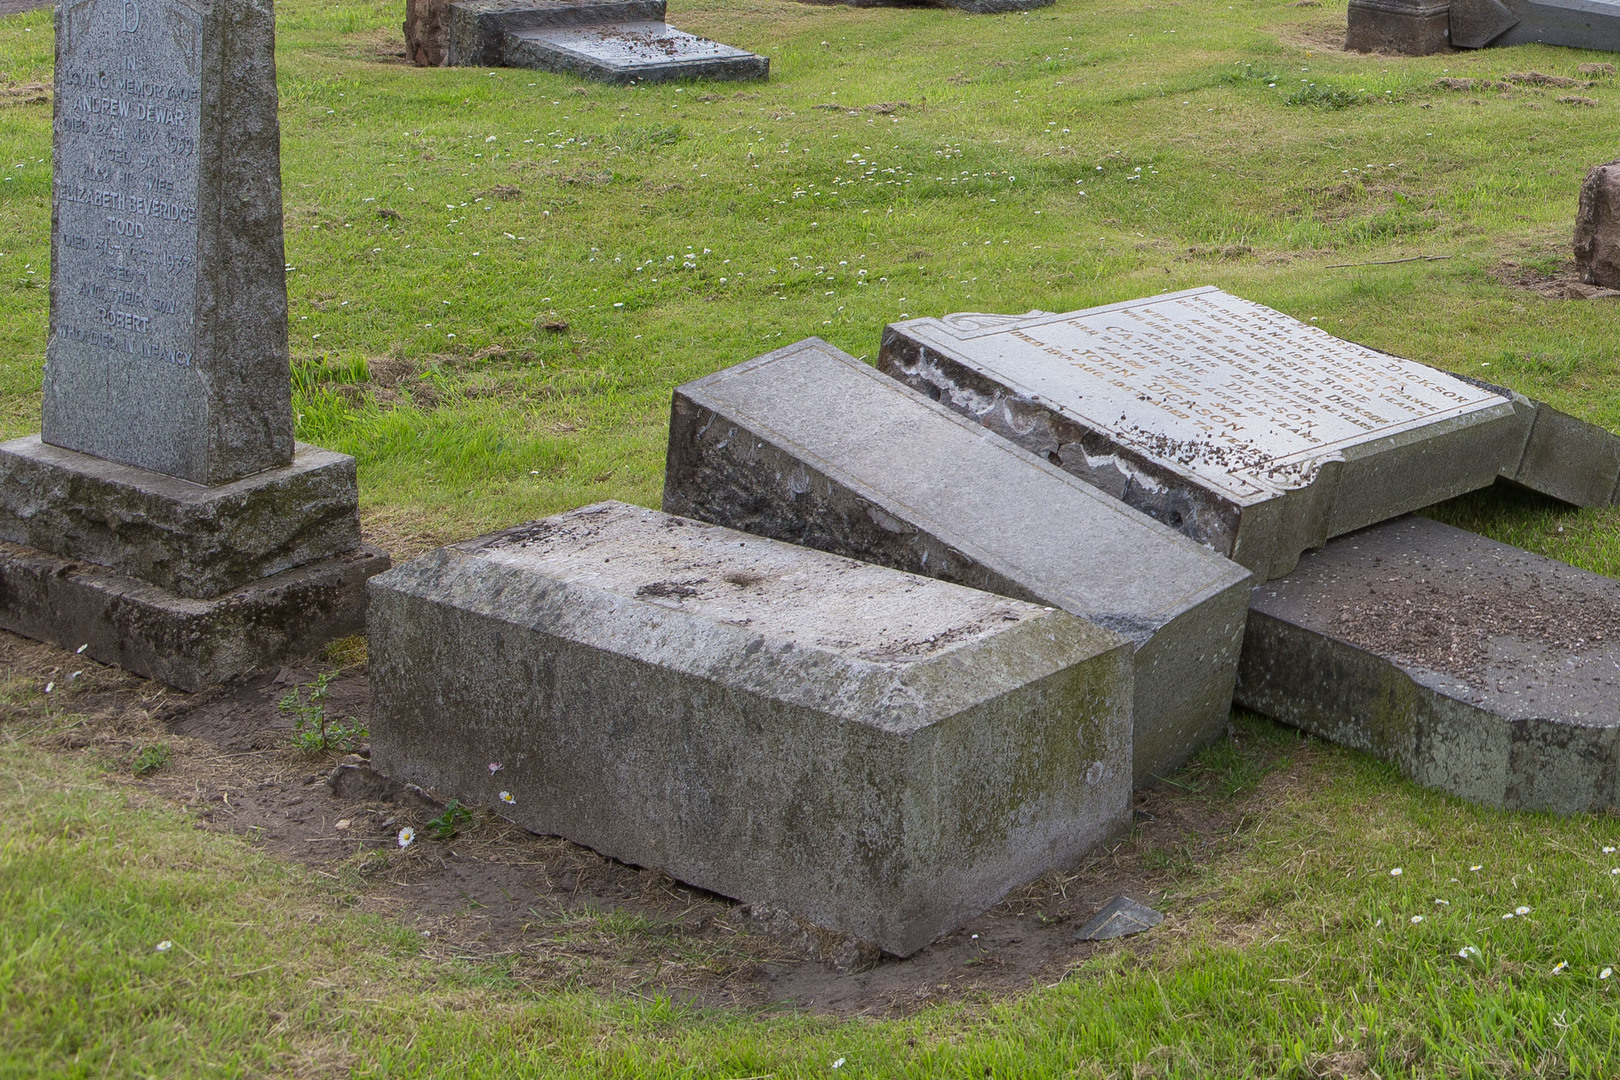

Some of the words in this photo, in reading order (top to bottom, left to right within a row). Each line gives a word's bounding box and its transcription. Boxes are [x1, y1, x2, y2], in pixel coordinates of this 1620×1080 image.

[121, 0, 140, 33] D
[124, 55, 136, 71] IN
[65, 70, 109, 90] LOVING
[117, 79, 174, 99] MEMORY
[63, 118, 89, 133] DIED
[74, 95, 130, 117] ANDREW
[137, 103, 185, 126] DEWAR
[98, 148, 132, 164] AGED
[60, 185, 125, 211] ELIZABETH
[129, 196, 197, 224] BEVERIDGE
[147, 176, 174, 195] WIFE
[63, 234, 89, 249] DIED
[107, 217, 144, 238] TODD
[101, 266, 133, 282] AGED
[96, 307, 149, 333] ROBERT
[109, 289, 144, 307] THEIR
[152, 298, 176, 314] SON
[58, 325, 85, 342] WHO
[89, 332, 118, 349] DIED
[141, 342, 193, 366] INFANCY
[1139, 332, 1185, 351] ALSO
[1187, 355, 1220, 367] HIS
[1187, 319, 1226, 335] ALSO
[1221, 335, 1244, 344] OF
[1246, 344, 1313, 376] JESSIE
[1316, 377, 1371, 403] BOGIE
[1189, 296, 1222, 309] WHO
[1217, 309, 1249, 323] DIED
[1266, 332, 1314, 354] HAVRE
[1383, 386, 1442, 412] FRANCE
[1246, 312, 1298, 334] ROYAL
[1299, 336, 1409, 387] HIGHLANDERS
[1291, 322, 1378, 360] ANDREW
[1382, 363, 1470, 403] DICKSON
[1006, 331, 1048, 348] DIED
[1146, 399, 1191, 419] AGED
[1064, 320, 1102, 336] DIED
[1203, 387, 1245, 405] AGED
[1266, 417, 1323, 444] YEARS
[1103, 350, 1147, 369] ALSO
[1152, 375, 1201, 396] THEIR
[1207, 401, 1249, 418] SON
[1106, 326, 1212, 375] CATHERINE
[1221, 382, 1317, 428] DICKSON
[1118, 309, 1146, 321] WHO
[1144, 321, 1173, 333] DIED
[1194, 346, 1261, 376] DECEMBER
[1289, 391, 1321, 404] AGED
[1337, 412, 1375, 431] YEARS
[1138, 309, 1171, 322] WIFE
[1217, 346, 1260, 364] ABOVE
[1258, 364, 1325, 394] WALTER
[1325, 395, 1391, 425] DICKSON
[1206, 315, 1286, 351] SEPTEMBER
[1285, 351, 1319, 365] 1914
[1316, 366, 1355, 382] AGED
[1378, 393, 1427, 416] YEARS
[1070, 349, 1136, 378] JOHN
[1144, 383, 1245, 432] DICKSON
